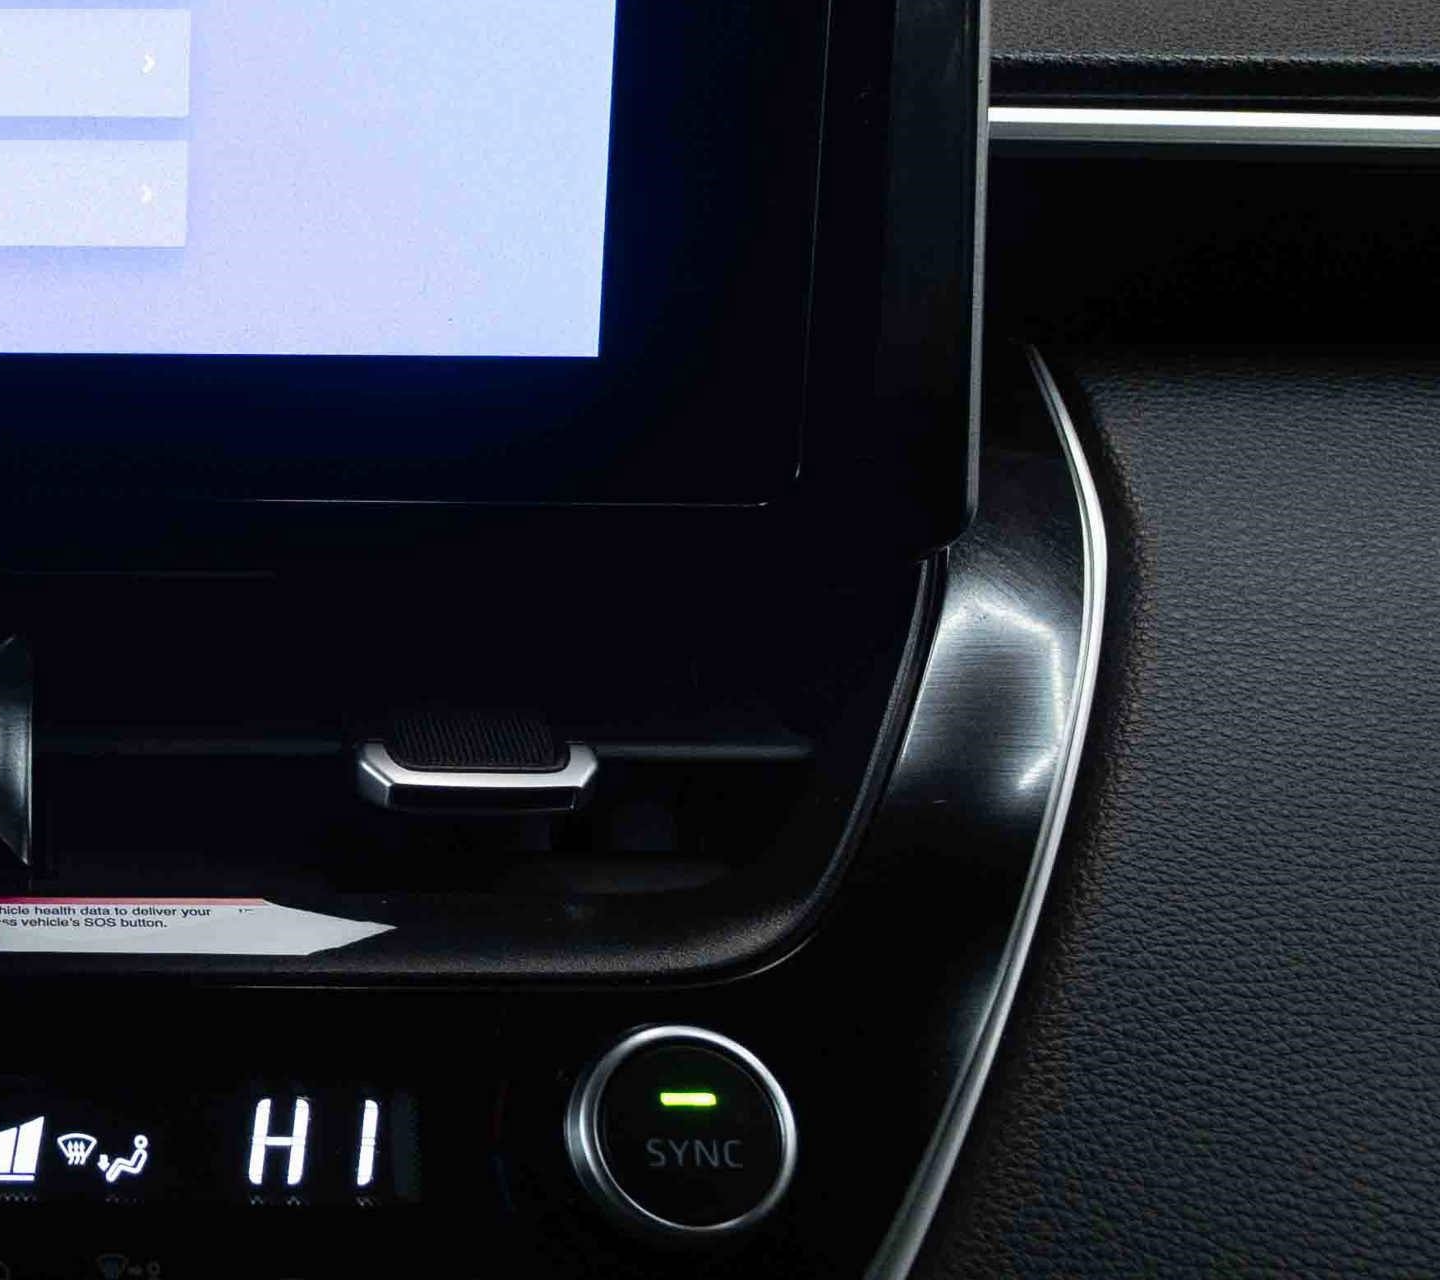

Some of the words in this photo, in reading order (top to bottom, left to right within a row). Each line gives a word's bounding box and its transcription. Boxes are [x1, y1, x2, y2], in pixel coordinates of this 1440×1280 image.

[34, 906, 76, 916] health
[80, 906, 110, 916] data
[114, 907, 127, 916] to
[132, 907, 176, 916] deliver
[181, 908, 211, 918] your
[21, 917, 80, 927] vehicle's
[84, 917, 116, 927] SOS
[121, 918, 167, 928] button.
[644, 1136, 745, 1171] SYNC
